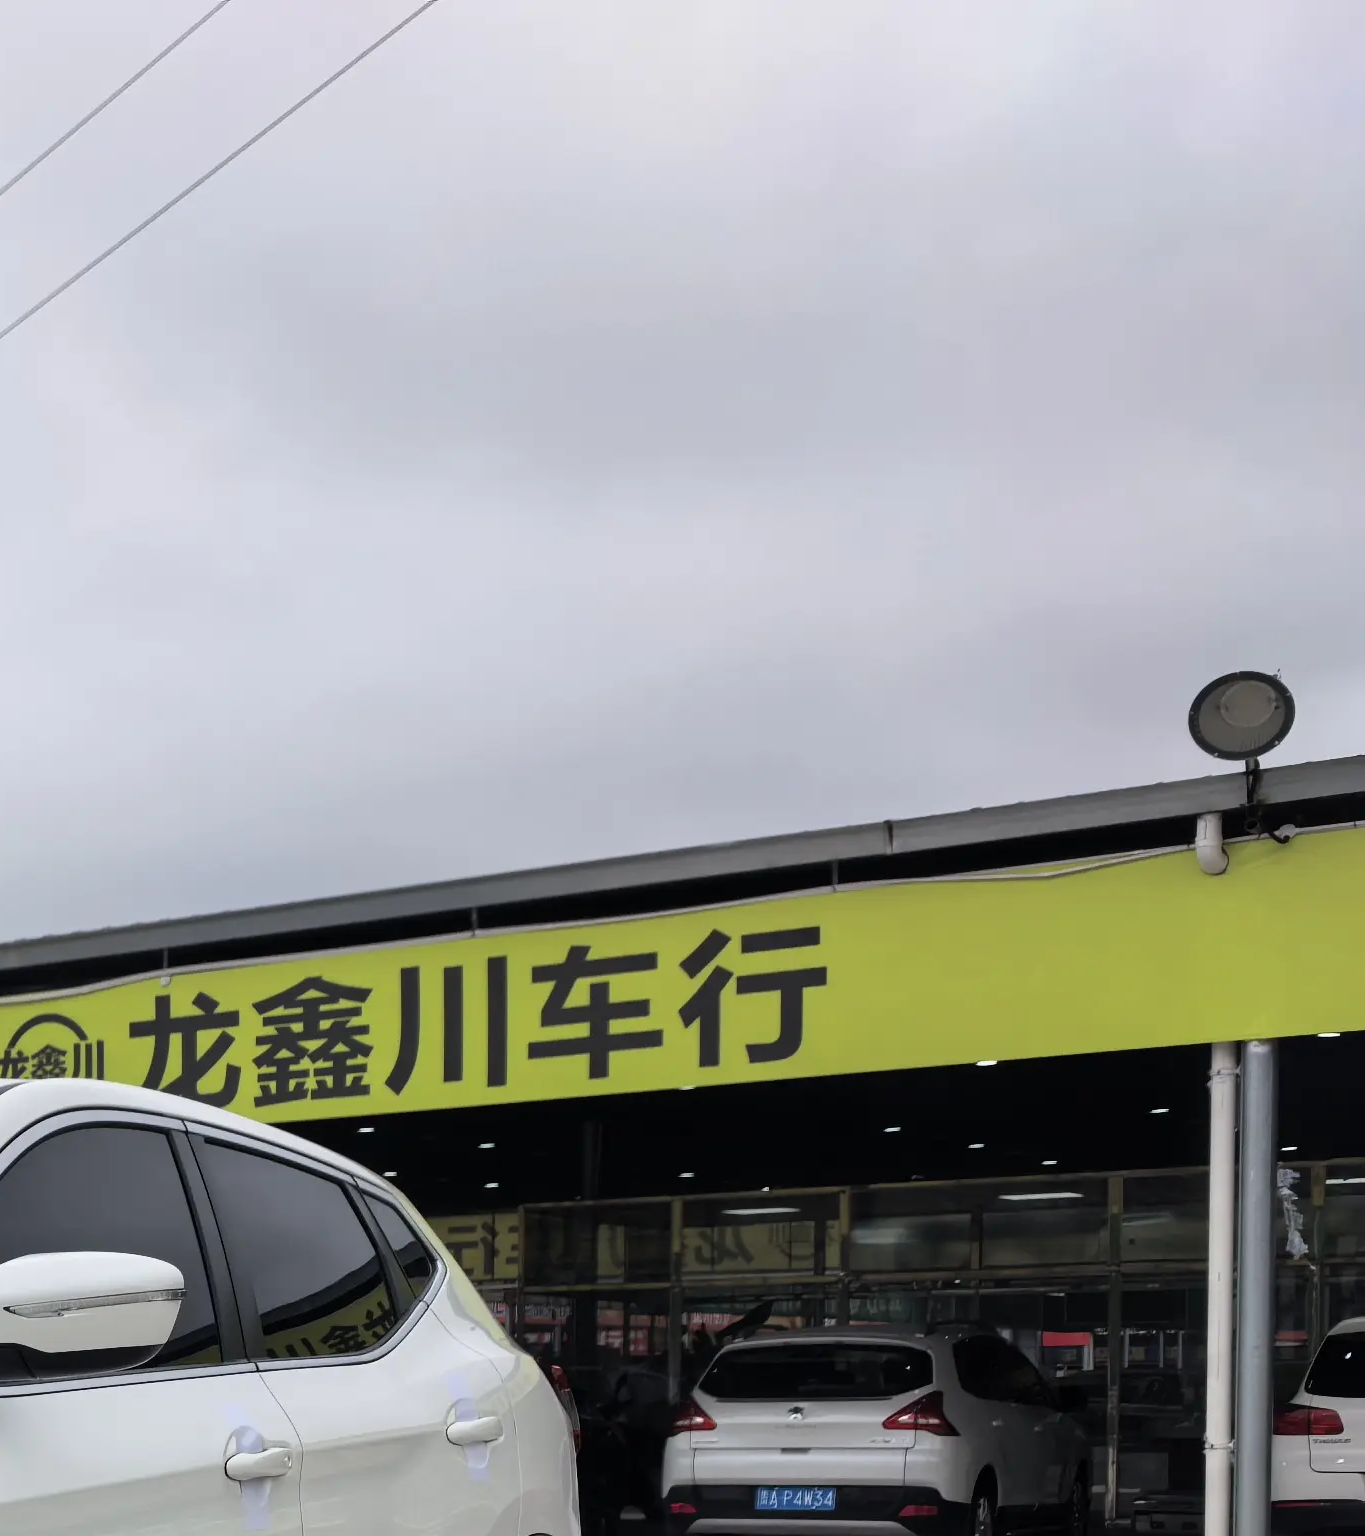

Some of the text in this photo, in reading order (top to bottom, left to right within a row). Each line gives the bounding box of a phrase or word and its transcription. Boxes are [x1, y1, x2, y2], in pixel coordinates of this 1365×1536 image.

[129, 927, 827, 1108] 龙鑫川车行
